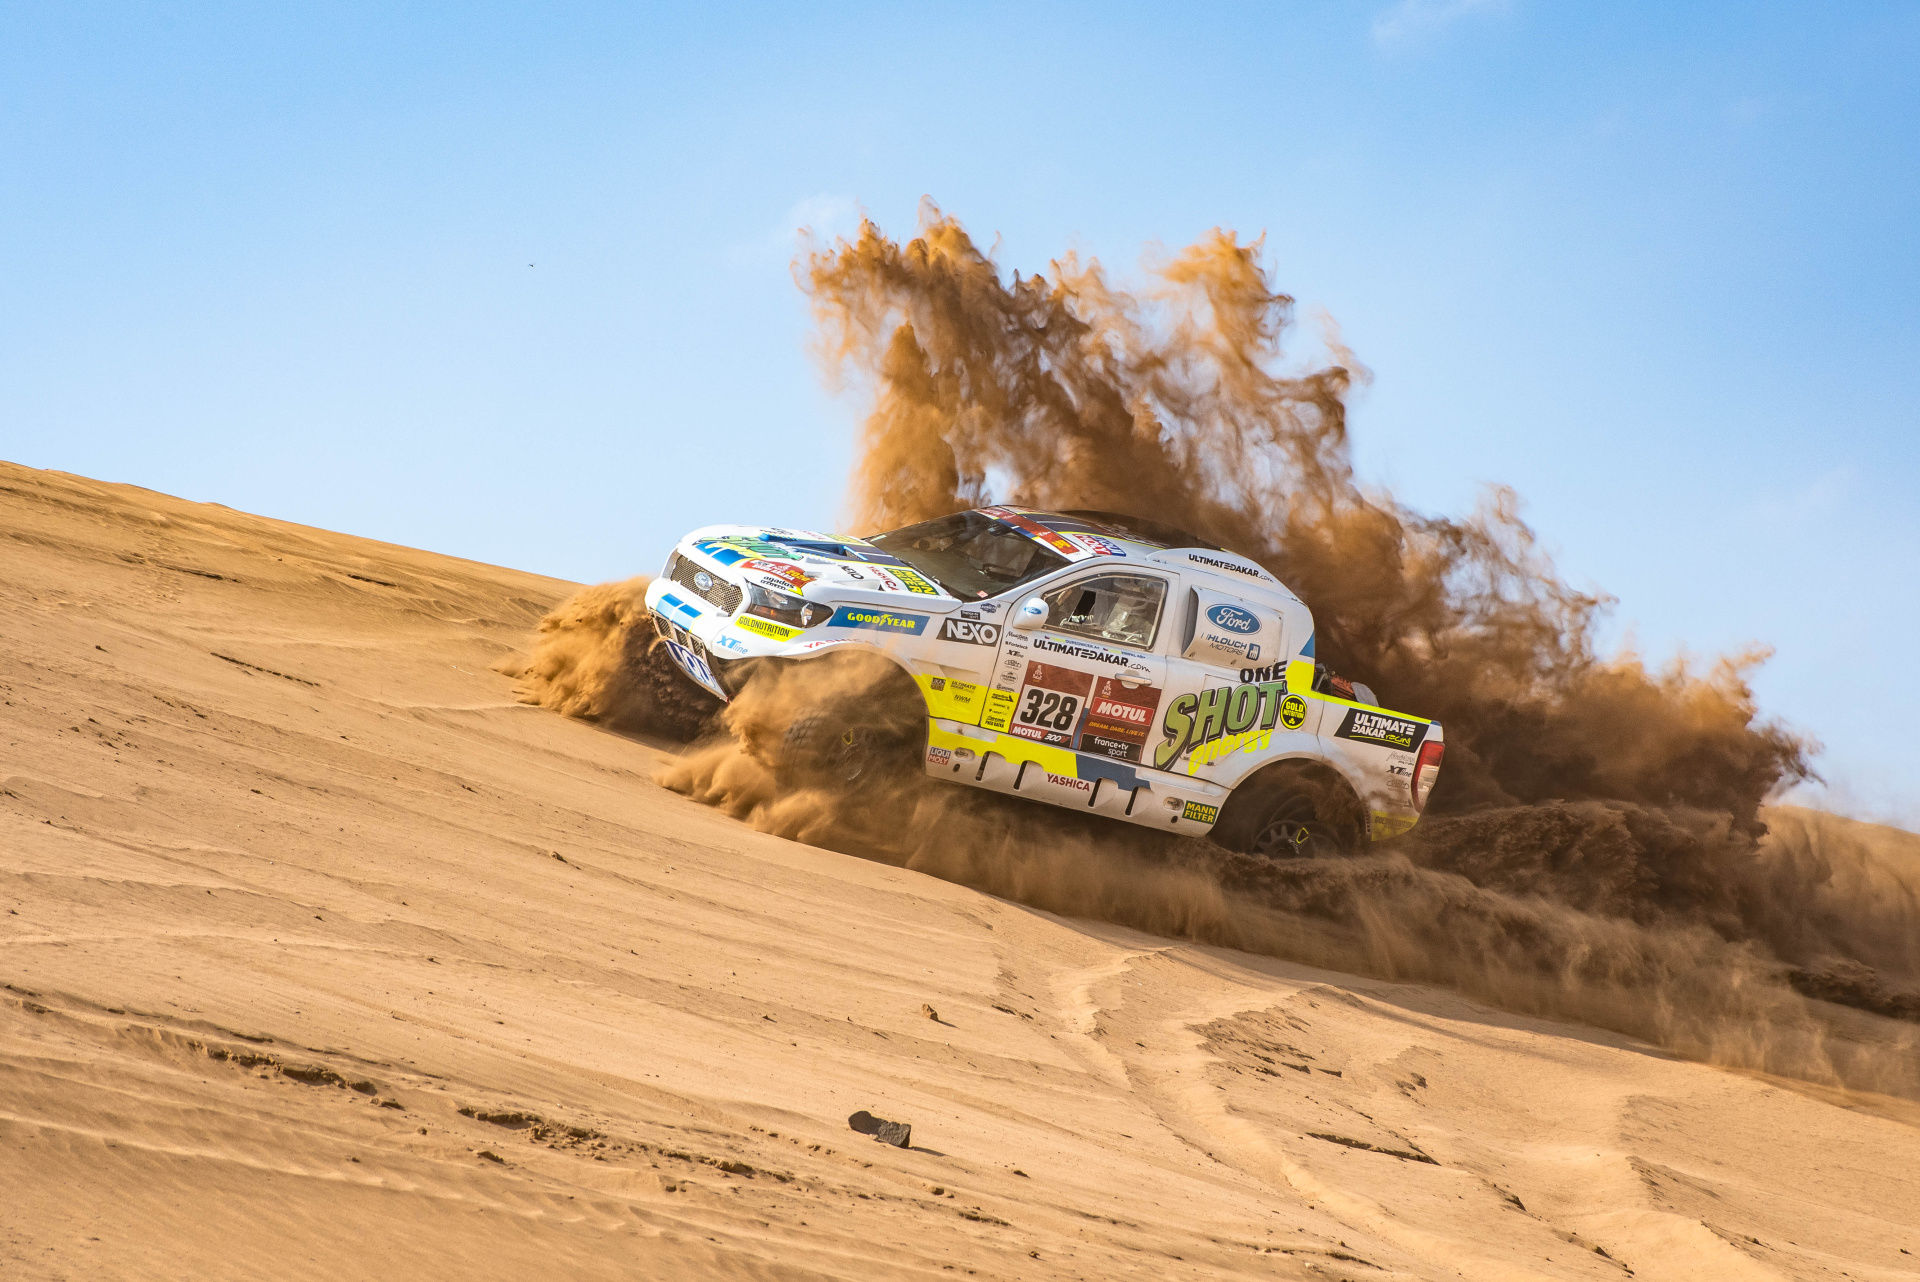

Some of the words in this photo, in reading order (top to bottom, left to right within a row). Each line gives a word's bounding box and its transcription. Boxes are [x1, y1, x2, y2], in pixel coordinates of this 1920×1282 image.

[739, 617, 790, 637] GOLDNUTRITION
[847, 612, 916, 629] GOODYEAR
[1216, 607, 1251, 631] Ford
[947, 620, 998, 645] NEXO
[717, 635, 748, 654] XTline
[1209, 643, 1245, 655] MOTORS
[1240, 660, 1288, 683] ONE
[1020, 689, 1078, 731] 328
[1097, 701, 1147, 722] MOTUL
[1285, 701, 1304, 713] GOLD
[1154, 680, 1288, 771] SHOT
[1354, 713, 1416, 736] ULTIMATE
[1012, 726, 1043, 739] MOTUL
[1044, 733, 1069, 743] 300V
[1351, 725, 1386, 738] DAKAR
[1385, 733, 1412, 747] racing
[928, 755, 949, 765] MOLY
[930, 747, 951, 758] LIQUI
[1108, 748, 1127, 758] sport
[1188, 728, 1274, 776] energy
[1386, 765, 1412, 777] XTline
[1047, 773, 1090, 792] YASHICA
[1184, 811, 1214, 823] FILTER
[1186, 803, 1216, 815] MANN
